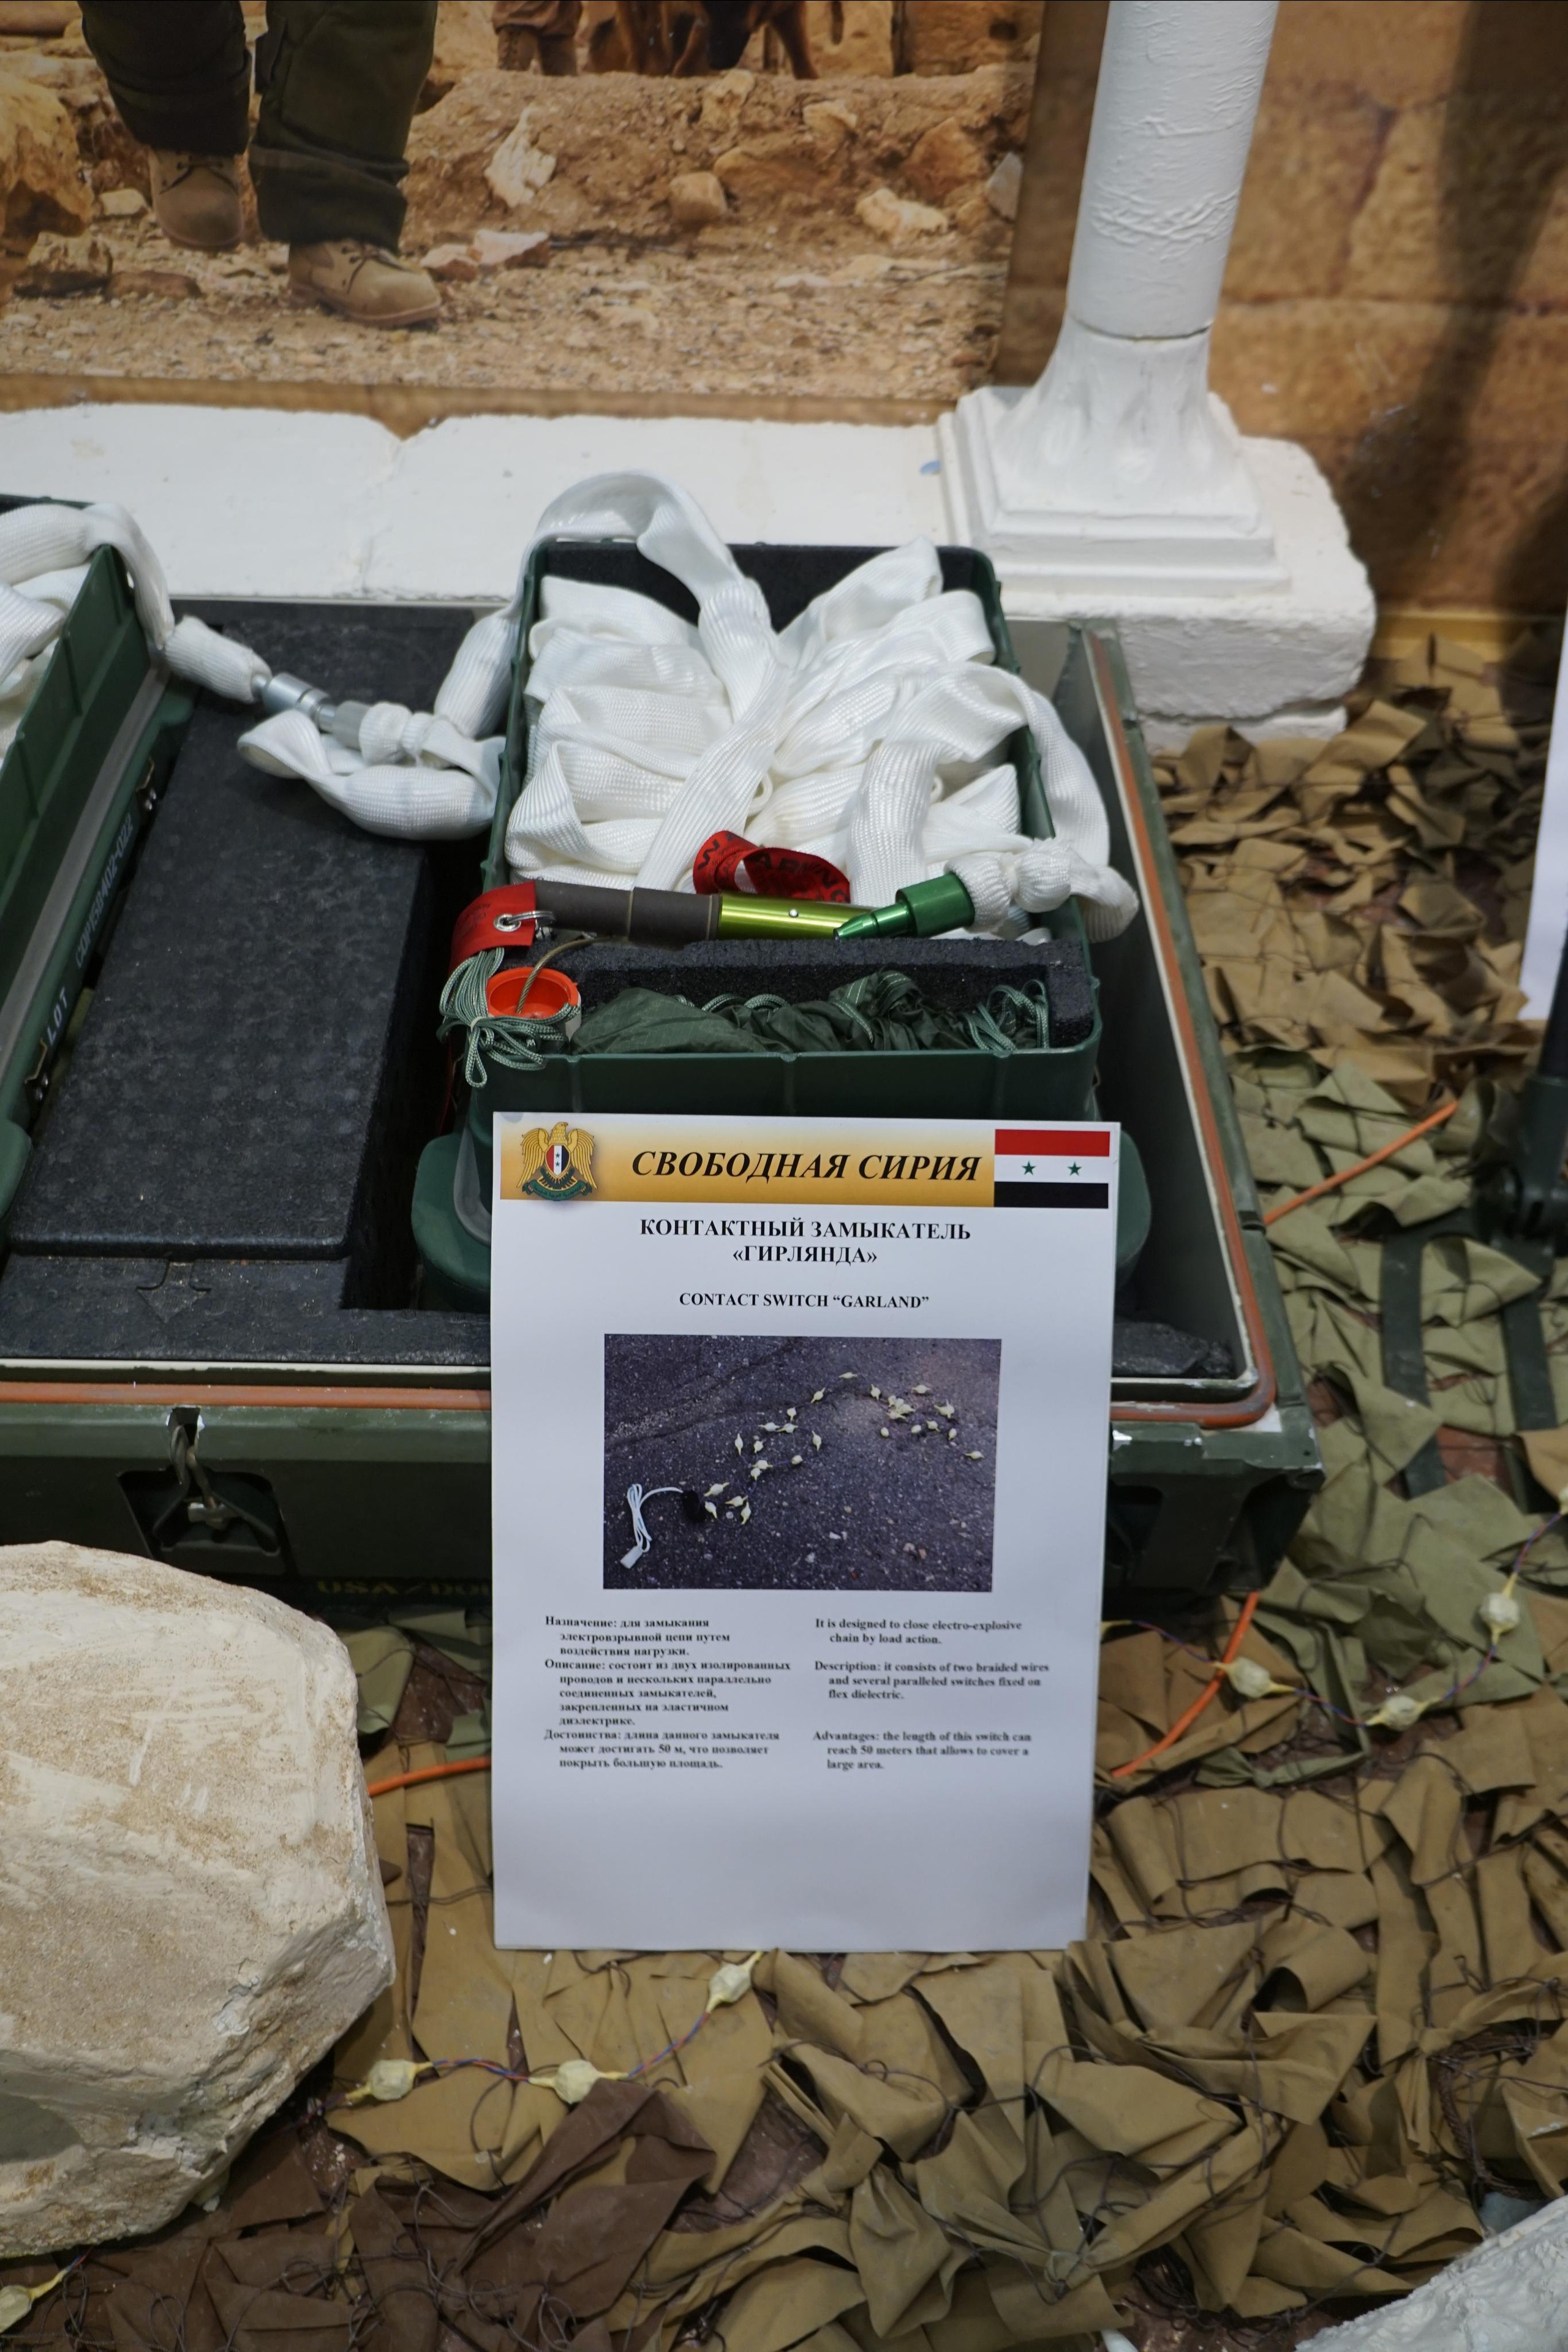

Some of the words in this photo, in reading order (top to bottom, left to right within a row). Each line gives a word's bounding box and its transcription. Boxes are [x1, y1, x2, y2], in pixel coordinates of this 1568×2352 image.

[47, 986, 67, 1046] LOT
[632, 1151, 850, 1183] СВОБОДНАЯ
[859, 1155, 982, 1180] СИРИЯ
[639, 1215, 805, 1237] КОНТАКТНЫЙ
[810, 1220, 971, 1240] ЗАМЫКАТЕЛЬ
[733, 1244, 878, 1267] «ГИРЛЯНДА»
[679, 1291, 760, 1306] CONTACT
[763, 1292, 829, 1307] SWITCH
[832, 1294, 930, 1308] “GARLAND”
[545, 1615, 616, 1627] Назначение:
[619, 1619, 640, 1628] для
[644, 1619, 709, 1627] замыкания
[815, 1617, 824, 1628] It
[827, 1618, 836, 1628] is
[839, 1617, 886, 1630] designed
[889, 1619, 900, 1629] to
[902, 1618, 929, 1629] close
[932, 1619, 1022, 1632] electro-explosive
[560, 1632, 662, 1645] электровзрывной
[665, 1634, 692, 1642] цепи
[696, 1634, 729, 1644] путем
[829, 1632, 859, 1643] chain
[862, 1632, 875, 1645] by
[878, 1632, 902, 1643] load
[905, 1634, 941, 1644] action.
[560, 1646, 630, 1656] воздействия
[633, 1647, 689, 1658] нагрузки.
[544, 1658, 605, 1670] Описание:
[671, 1661, 696, 1672] двух
[700, 1662, 790, 1672] изолированных
[814, 1660, 880, 1673] Description:
[884, 1660, 892, 1671] it
[894, 1662, 937, 1672] consists
[939, 1662, 951, 1672] of
[953, 1662, 973, 1672] two
[976, 1662, 1017, 1672] braided
[1020, 1662, 1049, 1672] wires
[559, 1675, 613, 1686] проводов
[696, 1676, 771, 1686] параллельно
[828, 1675, 849, 1685] and
[852, 1675, 891, 1685] several
[893, 1675, 948, 1688] paralleled
[950, 1676, 995, 1686] switches
[998, 1676, 1025, 1686] fixed
[559, 1689, 634, 1698] соединенных
[638, 1687, 716, 1698] замыкателей,
[828, 1688, 848, 1698] flex
[851, 1688, 903, 1699] dielectric.
[560, 1703, 641, 1714] закрепленных
[559, 1717, 635, 1727] диэлектрике.
[543, 1728, 620, 1740] Достоинства:
[624, 1731, 658, 1740] длина
[662, 1732, 707, 1740] данного
[711, 1732, 780, 1740] замыкателя
[813, 1730, 879, 1743] Advantages:
[883, 1730, 900, 1741] the
[902, 1730, 936, 1743] length
[939, 1730, 951, 1741] of
[952, 1730, 973, 1741] this
[975, 1731, 1009, 1741] switch
[598, 1745, 655, 1754] достигать
[658, 1743, 671, 1753] 50
[674, 1746, 686, 1754] м,
[712, 1746, 768, 1754] позволяет
[827, 1744, 857, 1754] reach
[860, 1744, 873, 1754] 50
[876, 1746, 913, 1755] meters
[915, 1744, 937, 1755] that
[940, 1744, 973, 1755] allows
[976, 1746, 987, 1755] to
[559, 1759, 609, 1770] покрыть
[612, 1757, 666, 1770] большую
[669, 1760, 722, 1768] площадь.
[827, 1758, 854, 1771] large
